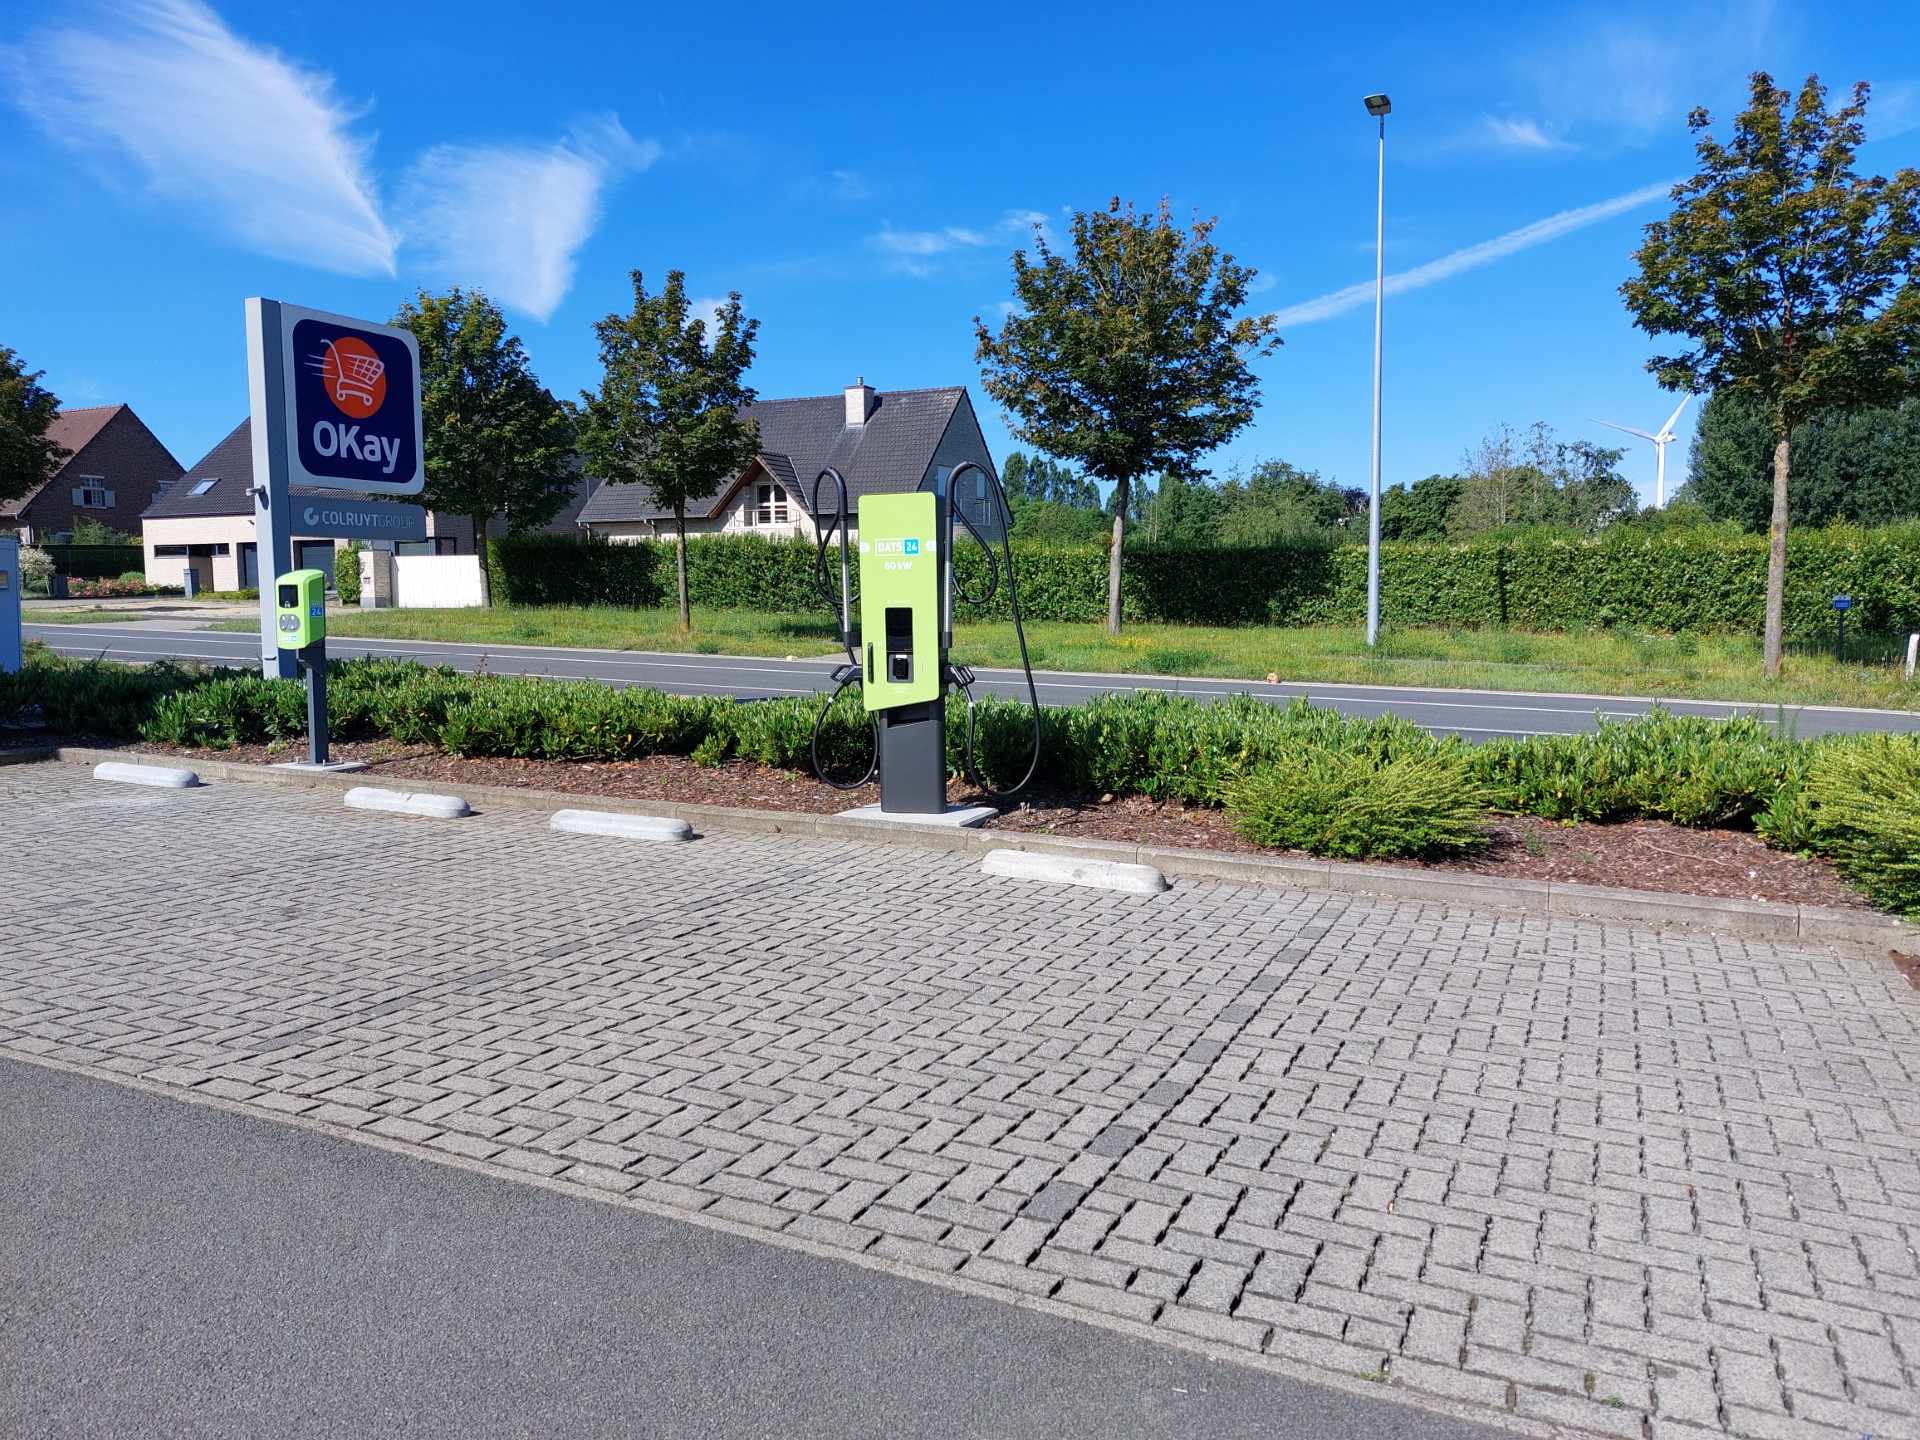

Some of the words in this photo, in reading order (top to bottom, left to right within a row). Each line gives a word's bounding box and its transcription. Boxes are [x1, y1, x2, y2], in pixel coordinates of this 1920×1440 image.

[313, 421, 401, 474] OKay
[322, 511, 415, 528] COLRUYTGROUP
[878, 542, 903, 553] DATS
[906, 541, 918, 552] 24
[898, 561, 913, 571] kW
[311, 608, 322, 616] 24
